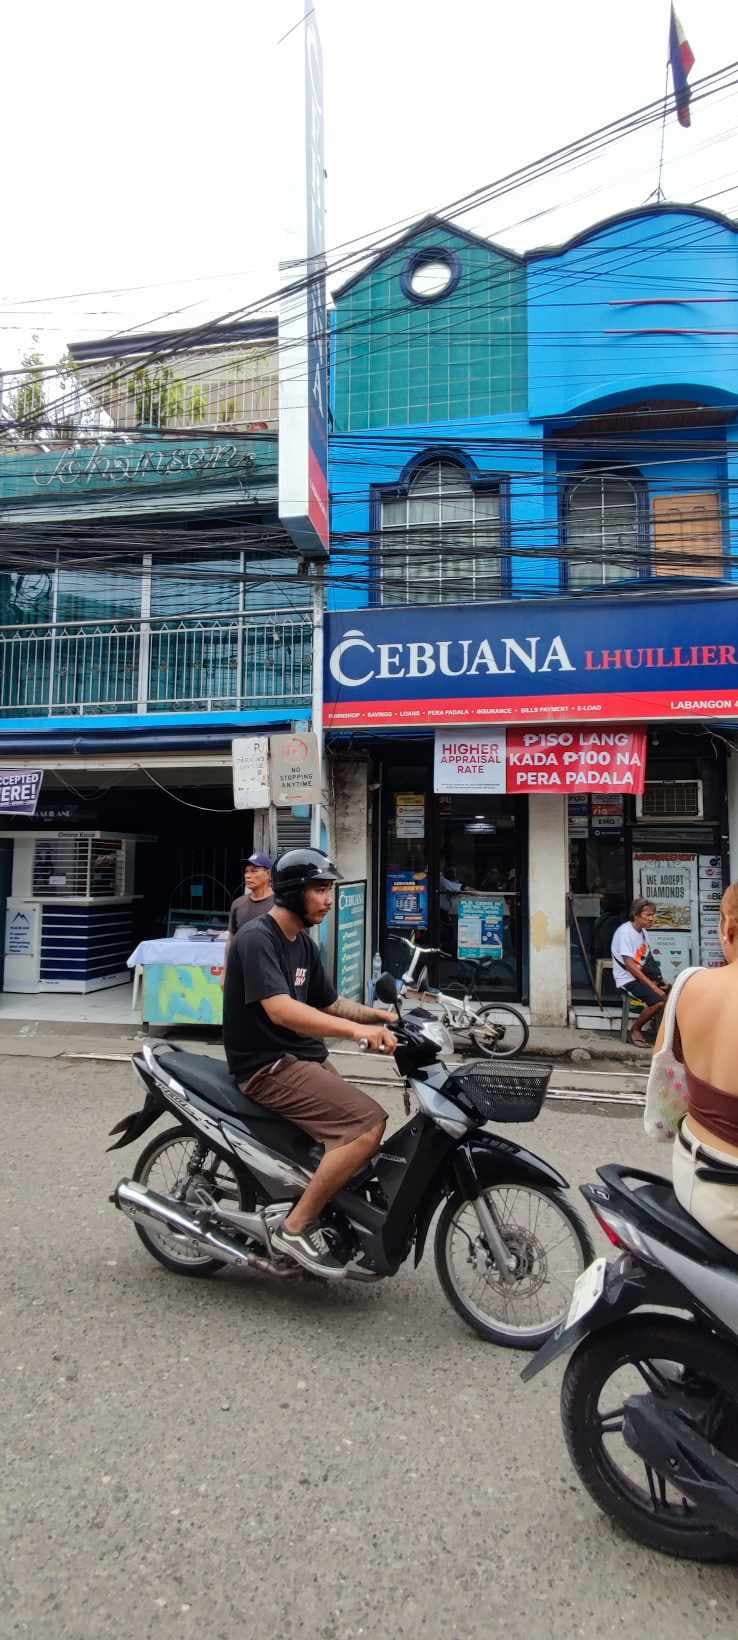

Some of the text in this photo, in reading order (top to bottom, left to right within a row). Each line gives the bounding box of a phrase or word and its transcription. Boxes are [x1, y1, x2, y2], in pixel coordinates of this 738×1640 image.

[330, 629, 738, 687] CEBUANA LHUILLIER
[671, 699, 732, 710] LABANGON
[445, 708, 469, 716] PADALA
[579, 733, 630, 746] LANG
[442, 743, 500, 755] HIGHER
[440, 754, 502, 764] APPRAISAL
[509, 752, 559, 766] KADA
[616, 752, 641, 767] NA
[457, 765, 485, 774] RATE
[279, 773, 313, 781] STOPPING
[516, 771, 634, 785] PERA PADALA
[281, 780, 313, 788] ANYTIME
[646, 874, 684, 886] WE ACCEPT
[645, 886, 685, 899] DIAMONDS
